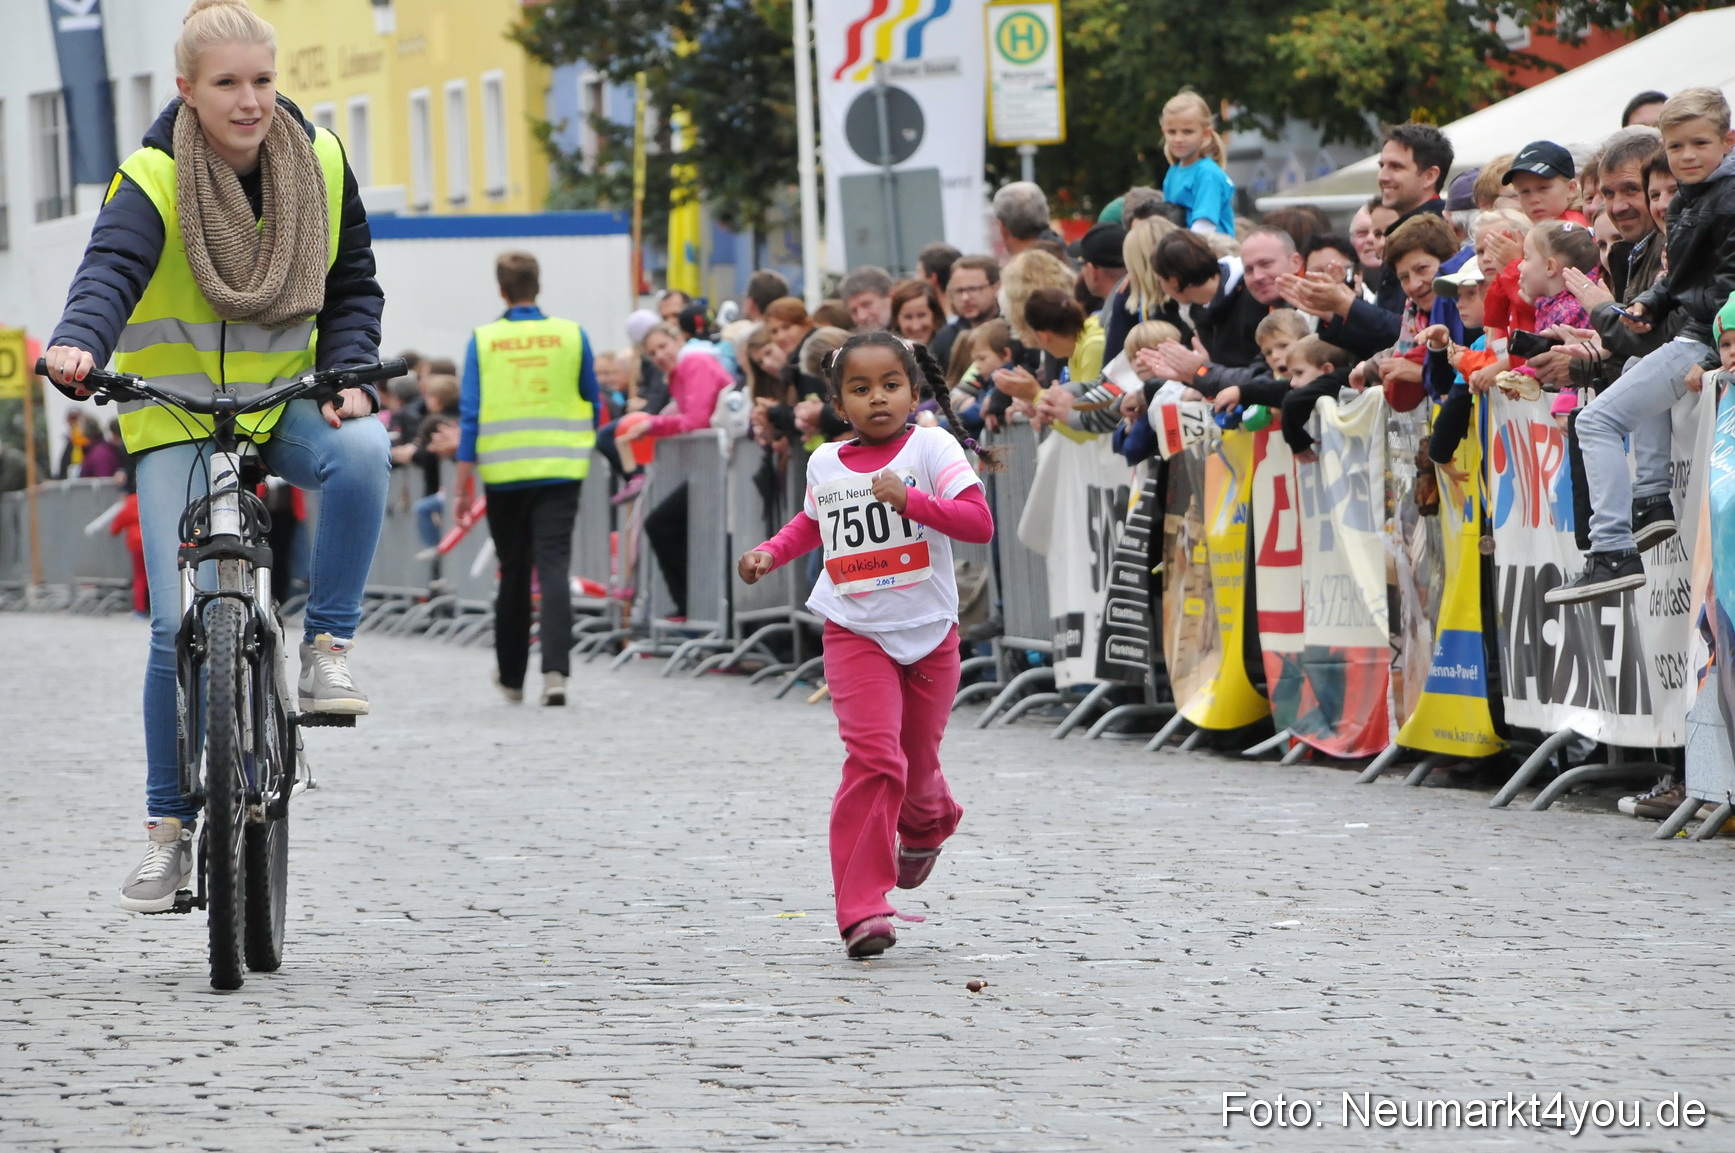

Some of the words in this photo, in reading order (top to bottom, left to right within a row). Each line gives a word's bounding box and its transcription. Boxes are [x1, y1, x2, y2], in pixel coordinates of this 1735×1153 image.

[491, 335, 562, 352] HELFER
[818, 491, 844, 507] PARTL
[846, 488, 874, 500] Neum
[841, 556, 889, 576] Lakisha
[876, 576, 896, 587] 2007
